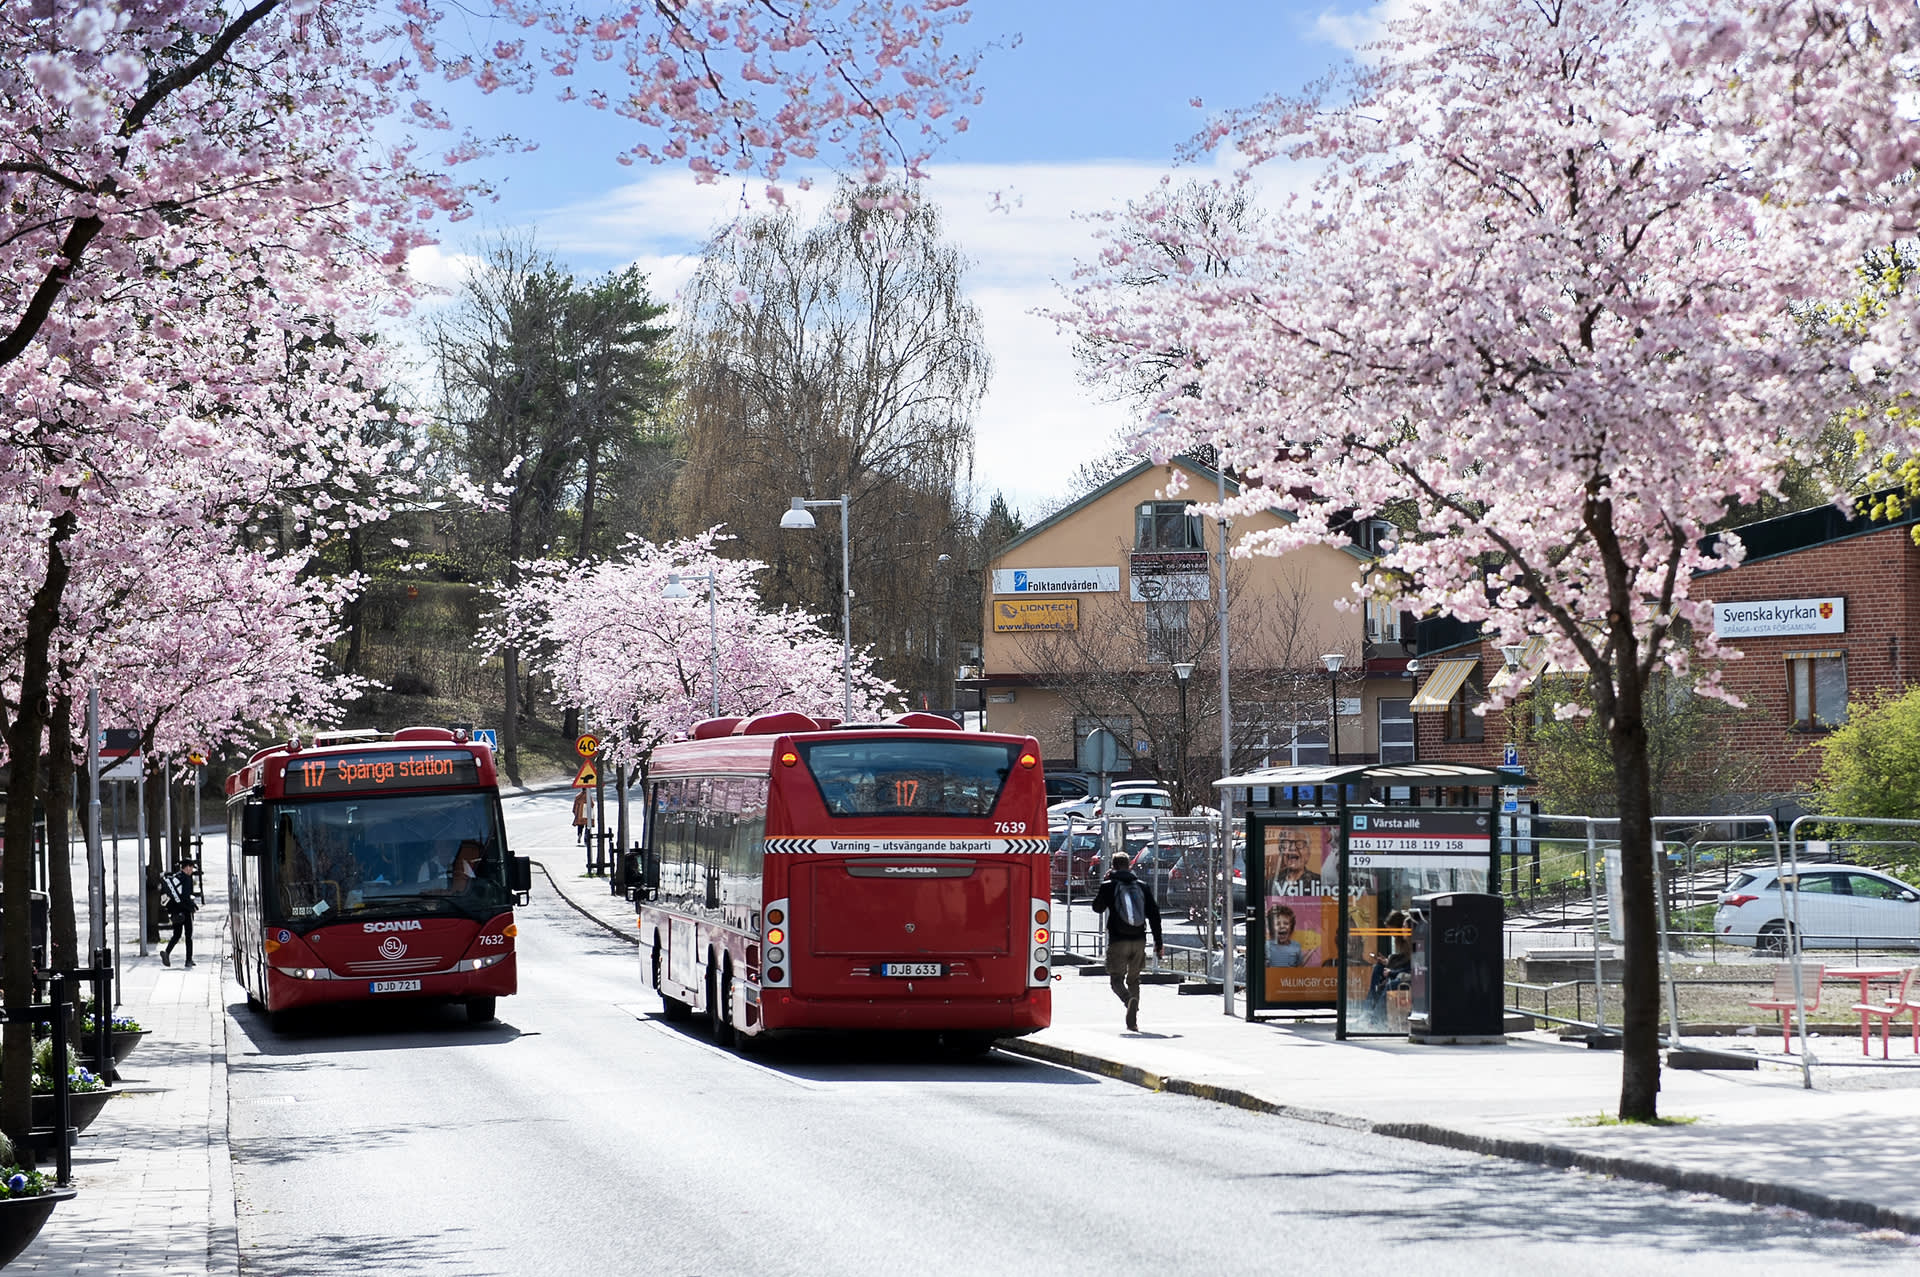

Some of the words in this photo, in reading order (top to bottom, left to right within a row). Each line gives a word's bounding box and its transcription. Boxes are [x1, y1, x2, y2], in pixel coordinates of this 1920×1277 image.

[1028, 580, 1098, 591] Folktandvården
[1020, 604, 1072, 612] LIONTECH
[1724, 607, 1773, 622] Svenska
[1775, 605, 1816, 623] kyrkan
[579, 740, 596, 752] 40
[301, 761, 326, 787] 117
[338, 758, 394, 783] Spånga
[400, 756, 453, 777] station
[895, 780, 918, 806] 117
[994, 822, 1026, 834] 7639
[1372, 817, 1402, 828] Värsta
[1404, 817, 1420, 828] allé
[831, 841, 870, 852] Varning
[883, 841, 946, 852] utsvängande
[950, 841, 991, 852] bakparti
[1353, 840, 1371, 849] 116
[1376, 840, 1393, 849] 117
[1400, 840, 1417, 849] 118
[1423, 840, 1440, 850] 119
[1446, 841, 1463, 850] 158
[1353, 857, 1371, 865] 199
[363, 920, 422, 933] SCANIA
[479, 934, 504, 945] 7632
[386, 941, 398, 950] SL
[890, 965, 913, 975] DJB
[916, 965, 937, 975] 633
[377, 982, 395, 991] DJD
[399, 981, 417, 990] 721
